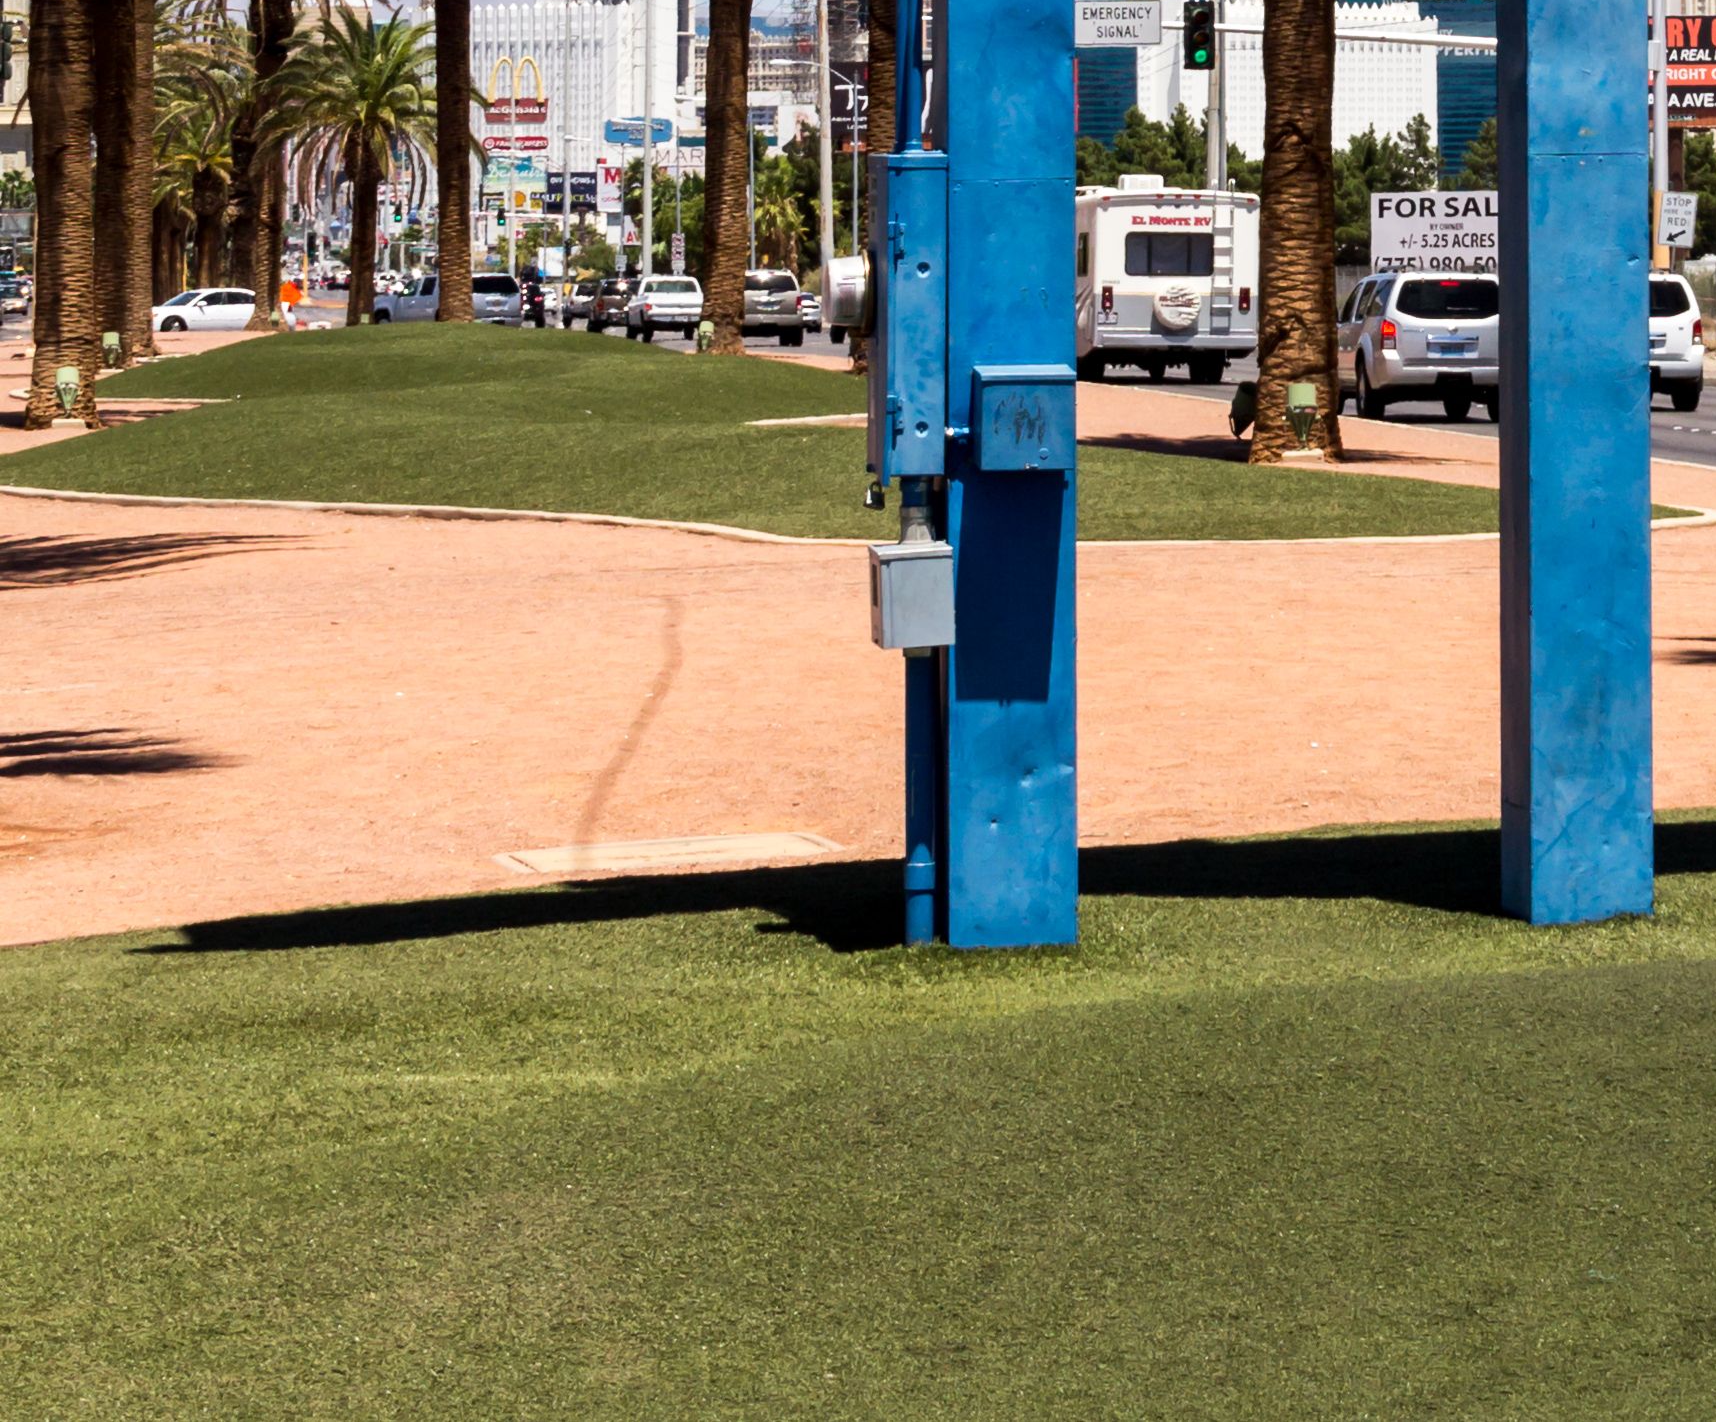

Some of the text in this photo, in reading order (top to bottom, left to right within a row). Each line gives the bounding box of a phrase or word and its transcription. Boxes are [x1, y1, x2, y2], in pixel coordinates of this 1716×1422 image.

[1082, 6, 1152, 20] EMERGENCY
[1096, 24, 1139, 38] SIGNAL
[1680, 49, 1712, 61] REAL
[1667, 67, 1707, 80] RIGHT
[1378, 197, 1498, 218] FOR SAL
[1666, 197, 1692, 207] STOP
[1132, 216, 1212, 226] EL MONTE RV
[1667, 217, 1687, 227] RED
[1400, 233, 1495, 249] +/- 5.25 ACRES
